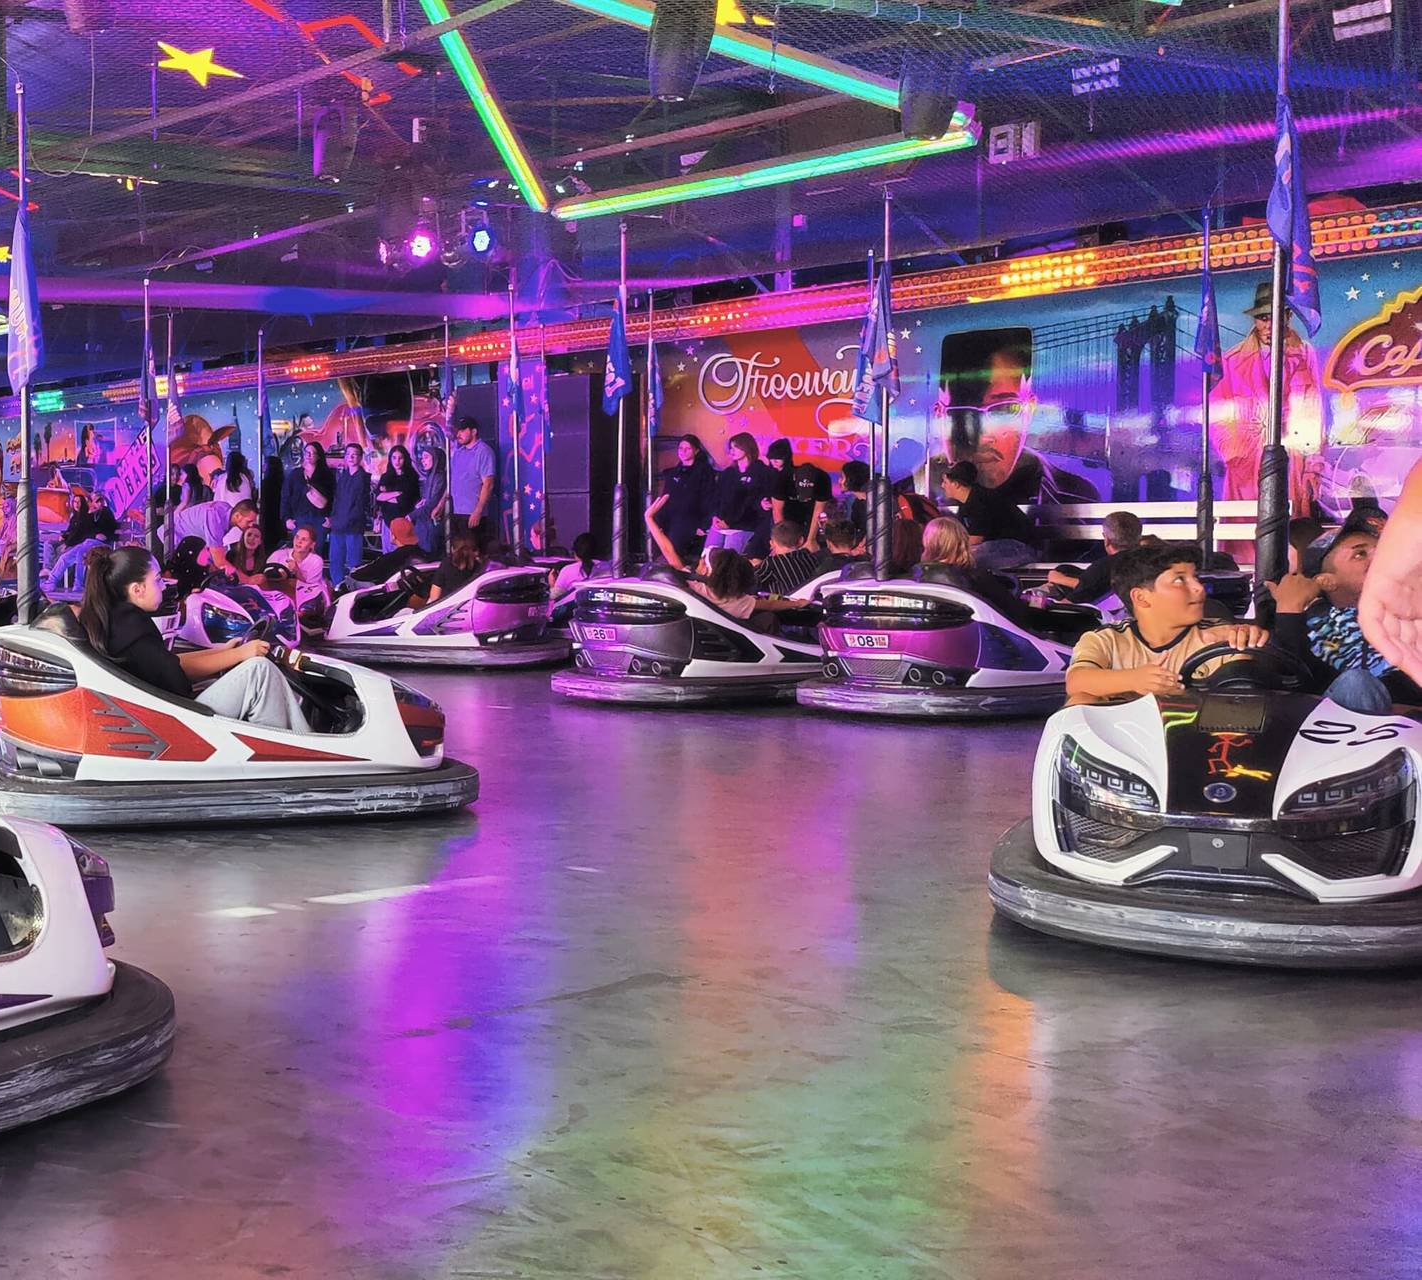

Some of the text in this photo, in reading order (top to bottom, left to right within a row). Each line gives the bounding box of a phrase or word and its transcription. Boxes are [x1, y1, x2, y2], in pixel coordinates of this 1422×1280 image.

[698, 345, 862, 416] Freewa
[593, 629, 606, 640] 26
[857, 635, 875, 647] 08
[1299, 720, 1414, 747] 25
